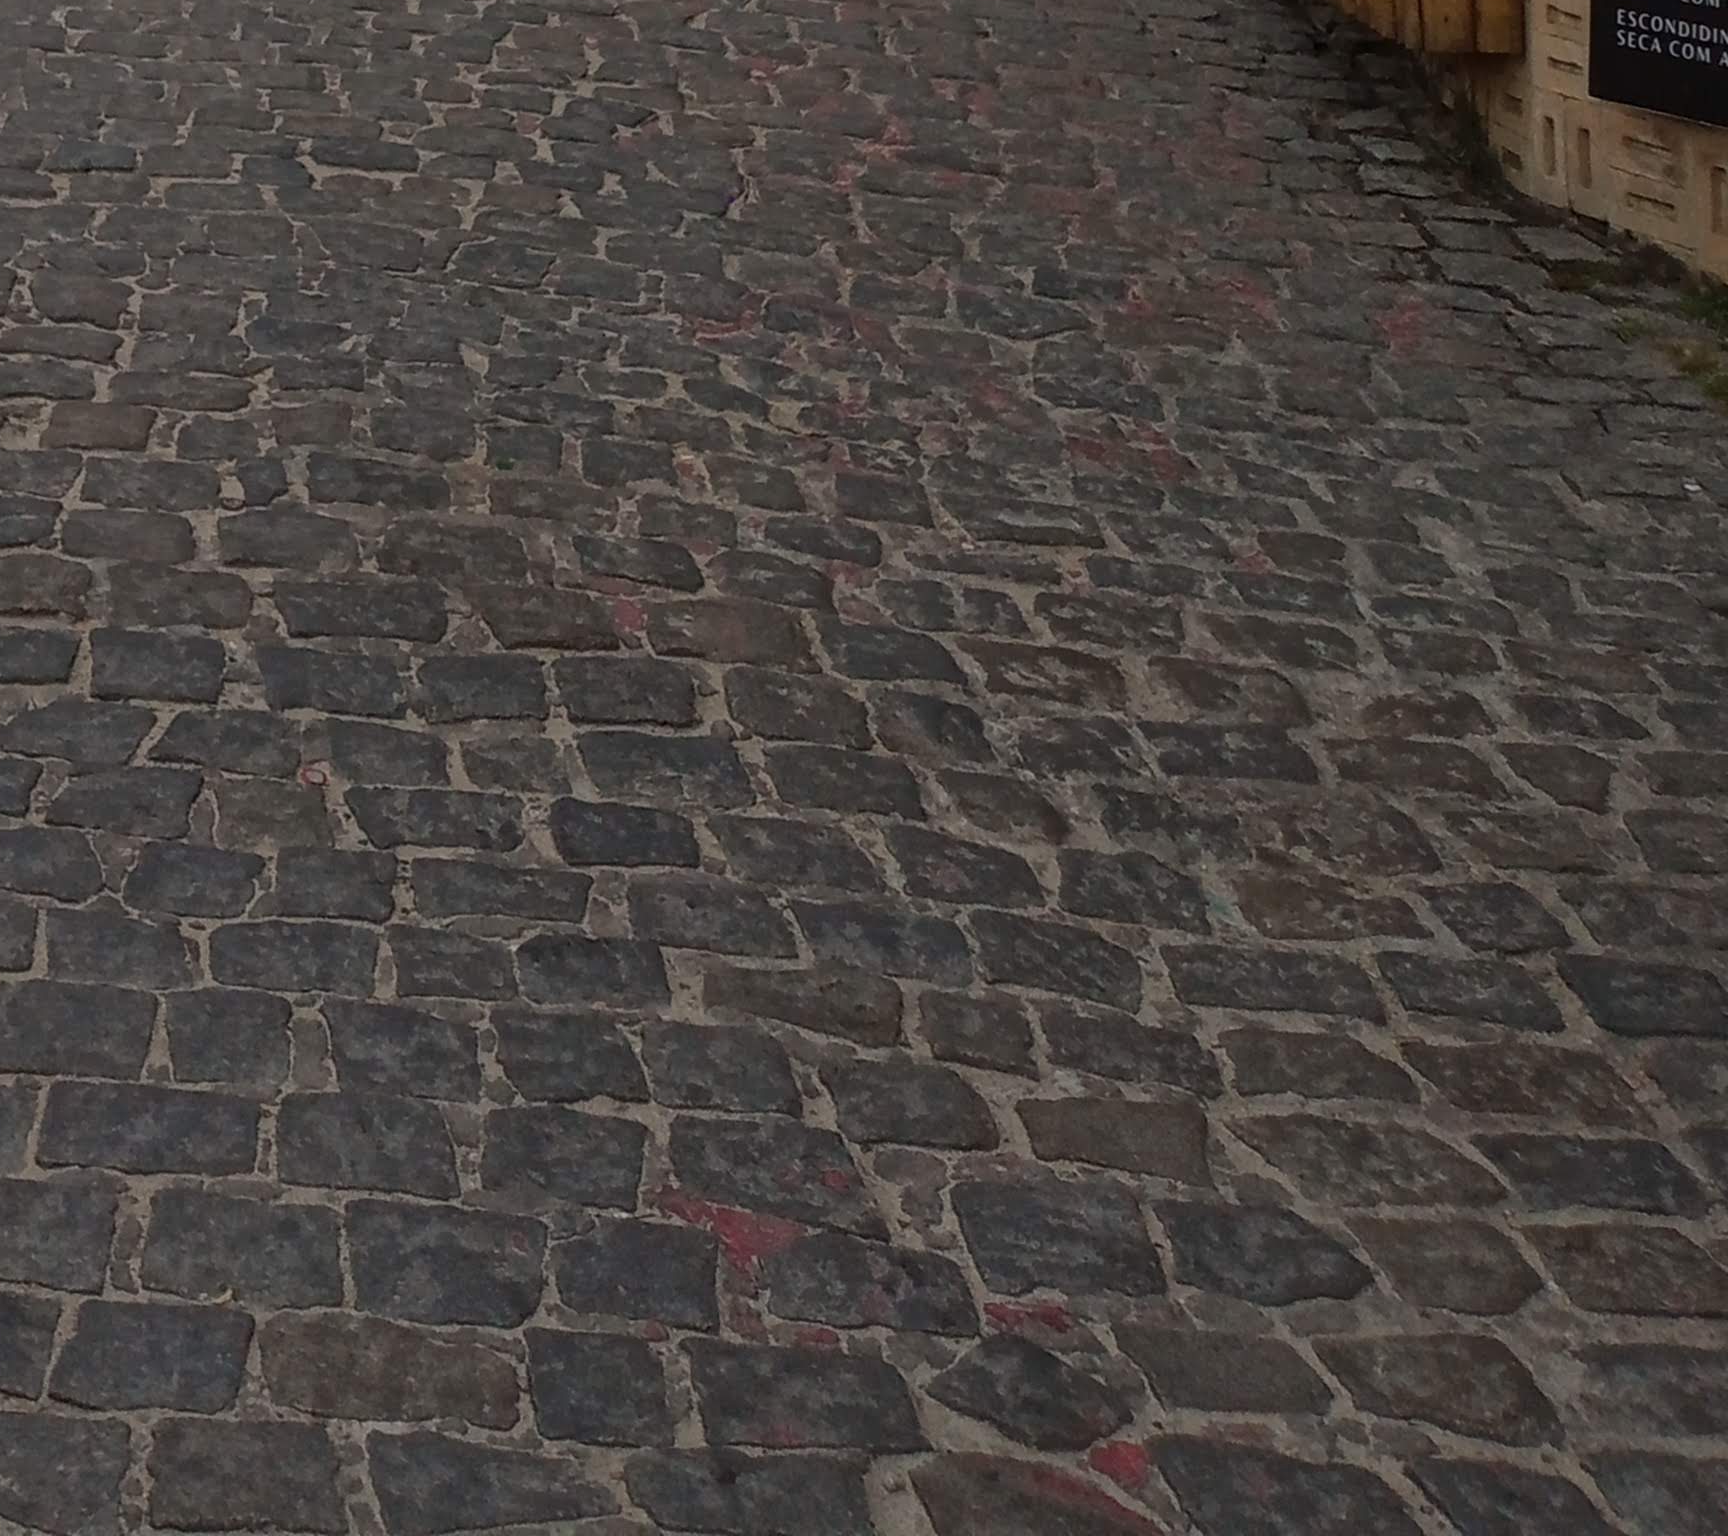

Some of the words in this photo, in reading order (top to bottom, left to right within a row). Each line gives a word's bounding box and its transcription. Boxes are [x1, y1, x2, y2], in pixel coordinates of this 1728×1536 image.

[1616, 8, 1728, 45] ESCONDIDIN
[1616, 29, 1663, 55] SECA
[1669, 39, 1712, 65] COM
